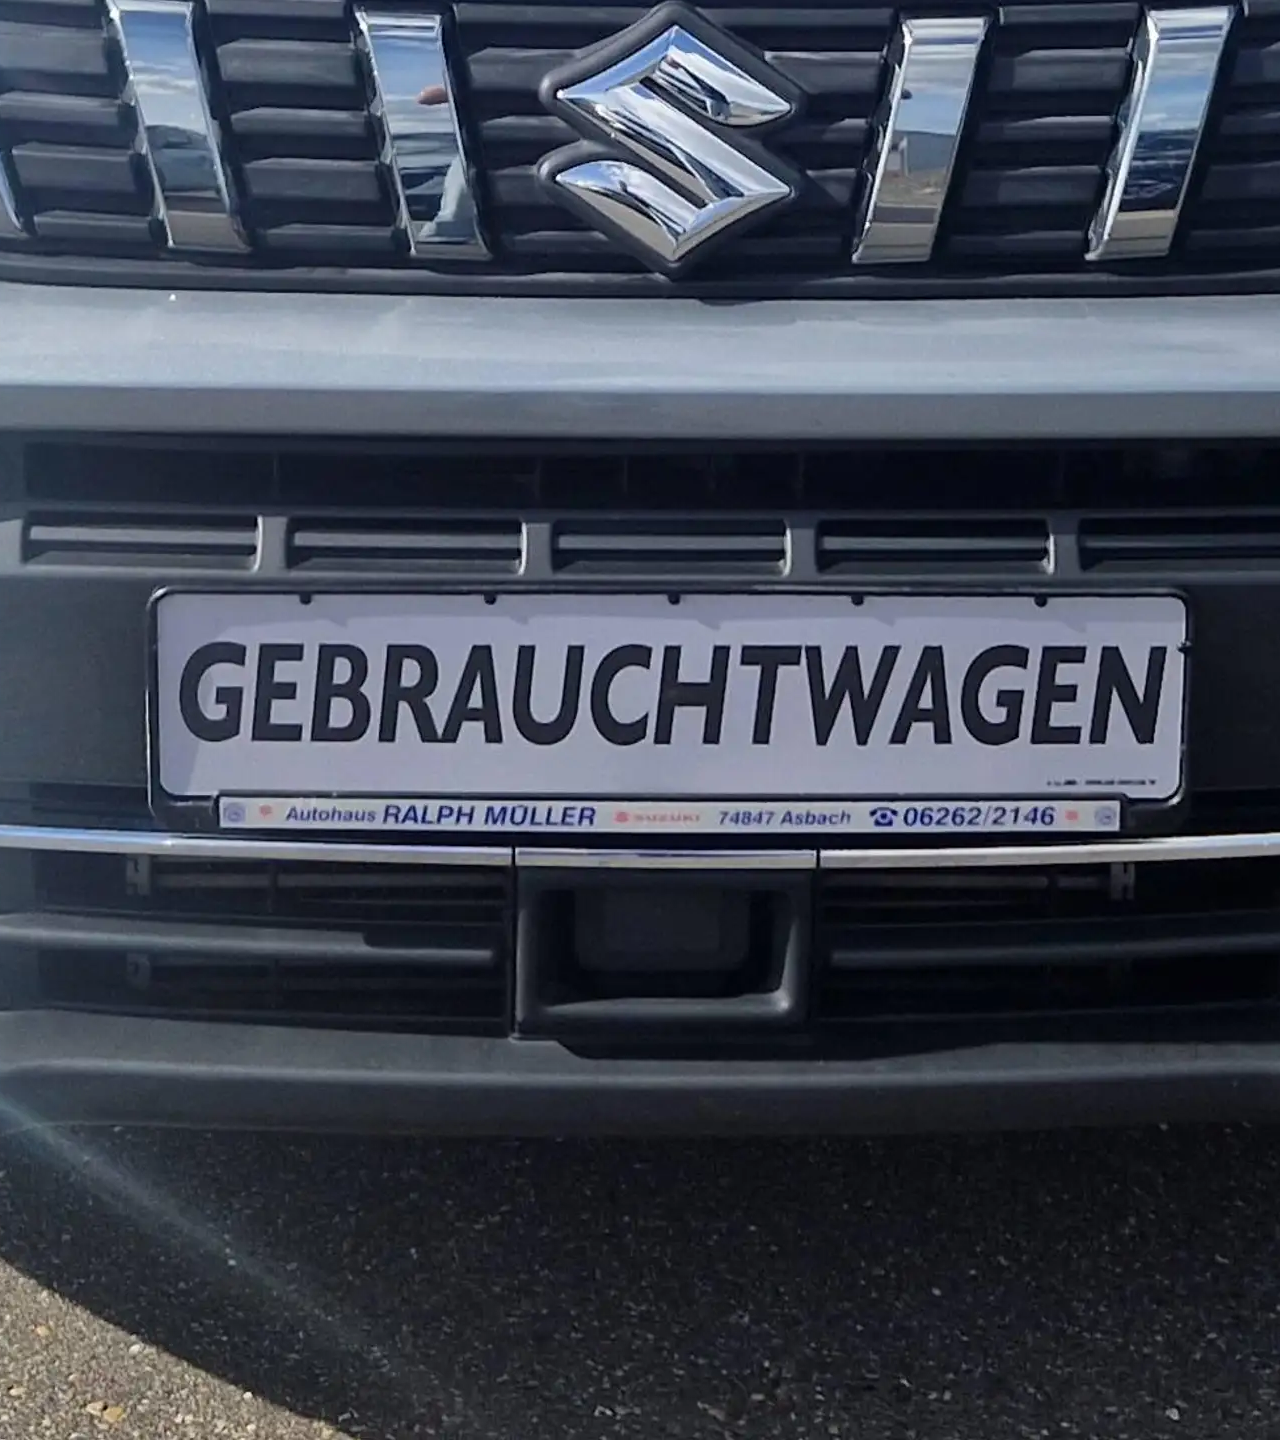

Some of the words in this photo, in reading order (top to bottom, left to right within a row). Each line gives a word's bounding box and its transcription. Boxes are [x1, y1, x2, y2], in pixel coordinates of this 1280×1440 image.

[178, 641, 1168, 746] GEBRAUCHTWAGEN
[285, 806, 376, 823] Autohaus
[382, 804, 476, 825] RALPH
[484, 804, 597, 827] MÜLLER
[719, 811, 775, 826] 74847
[780, 810, 852, 826] Asbach
[903, 806, 1057, 827] 06262/2146
